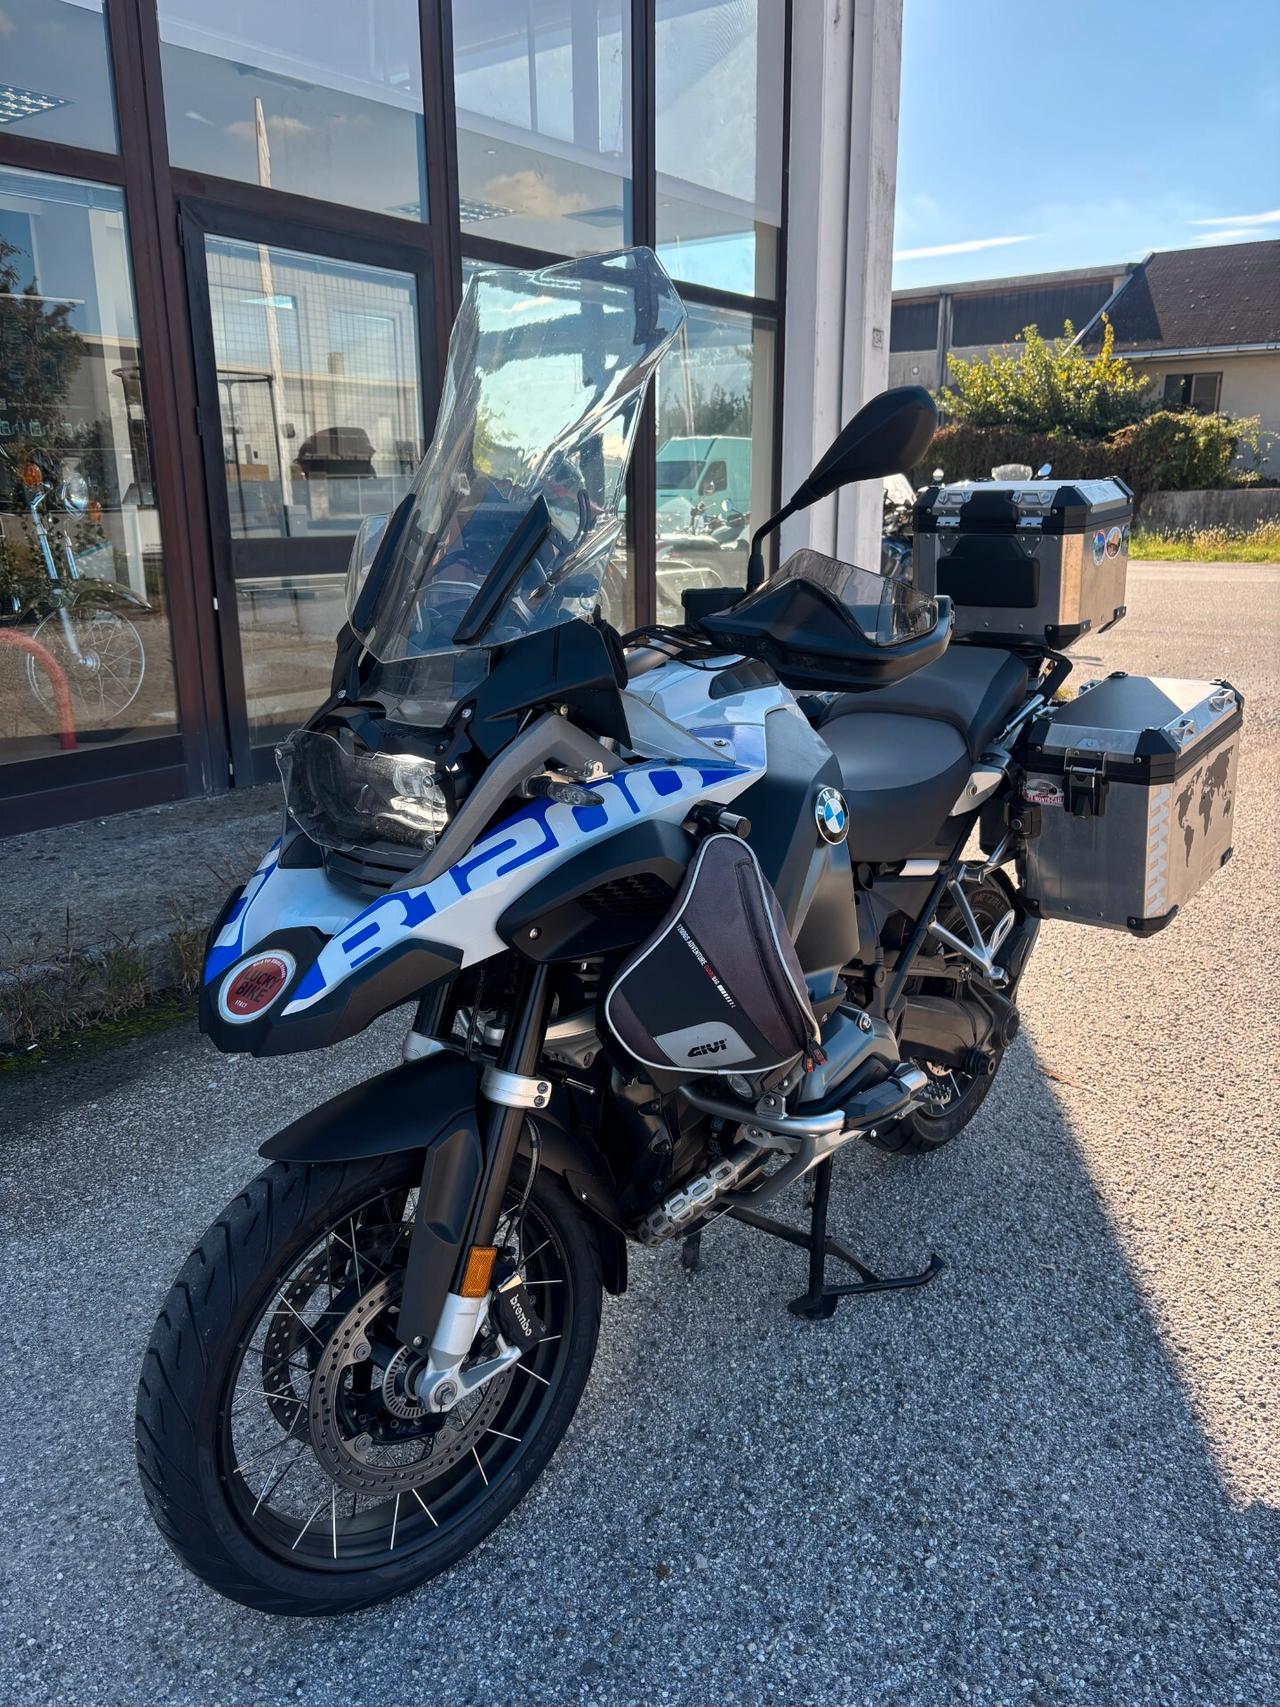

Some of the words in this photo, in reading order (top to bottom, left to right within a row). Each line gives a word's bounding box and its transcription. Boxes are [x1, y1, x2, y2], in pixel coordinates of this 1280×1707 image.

[817, 790, 841, 816] BMW
[687, 940, 708, 967] ADVENTURE
[246, 969, 278, 989] LUCKY
[234, 981, 268, 1003] BIKE
[687, 1039, 727, 1057] GIVI
[509, 1293, 533, 1337] brembo
